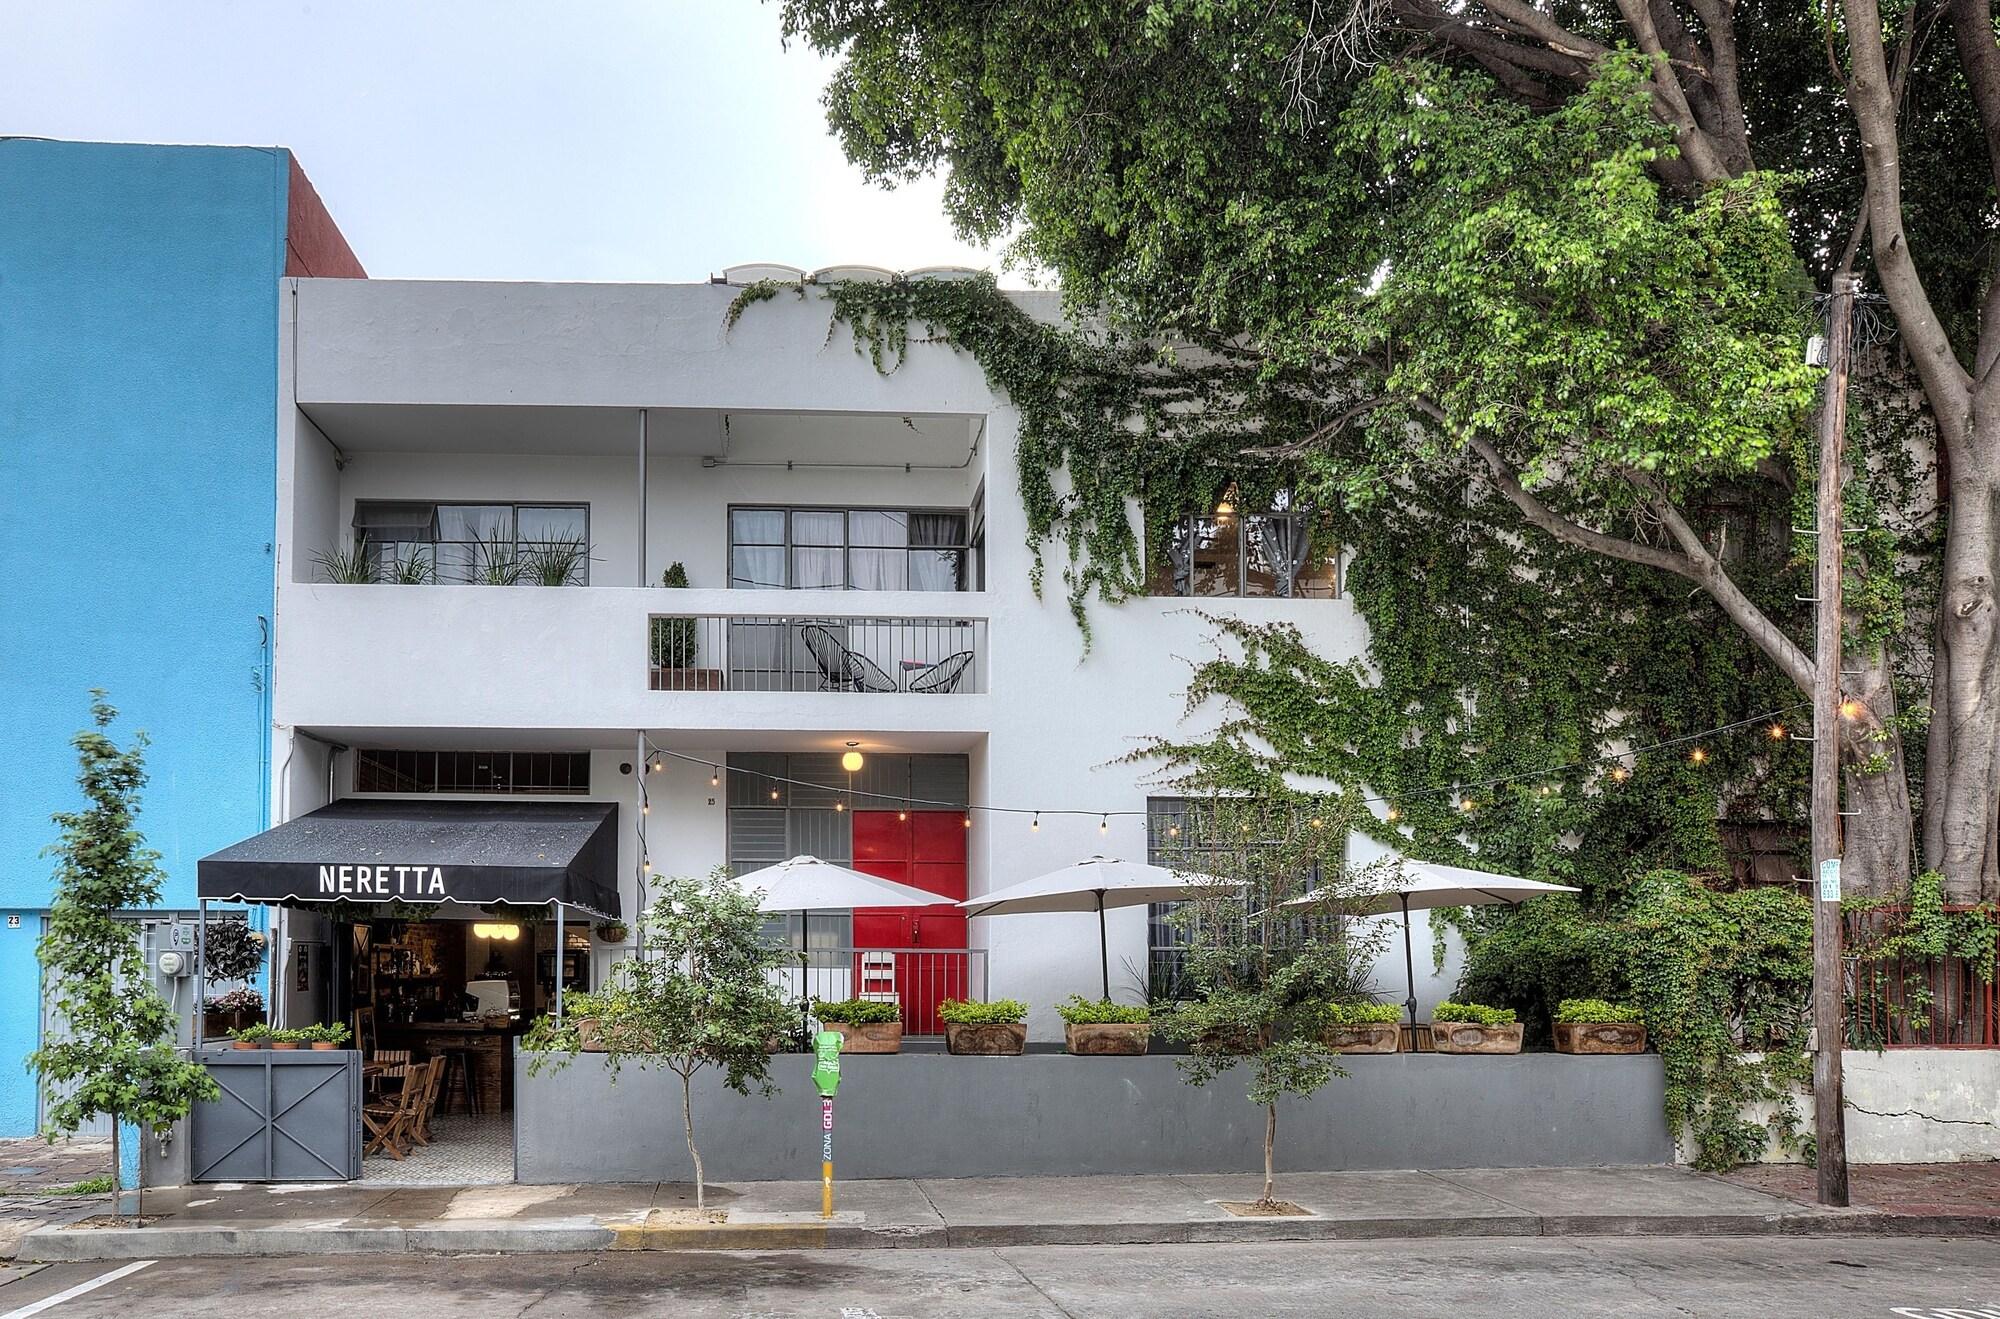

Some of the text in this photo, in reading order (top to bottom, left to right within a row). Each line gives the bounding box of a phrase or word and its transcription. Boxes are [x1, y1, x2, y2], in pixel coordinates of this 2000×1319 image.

[319, 865, 446, 895] NERETTA
[8, 916, 20, 925] 23
[823, 1133, 832, 1161] ZONA
